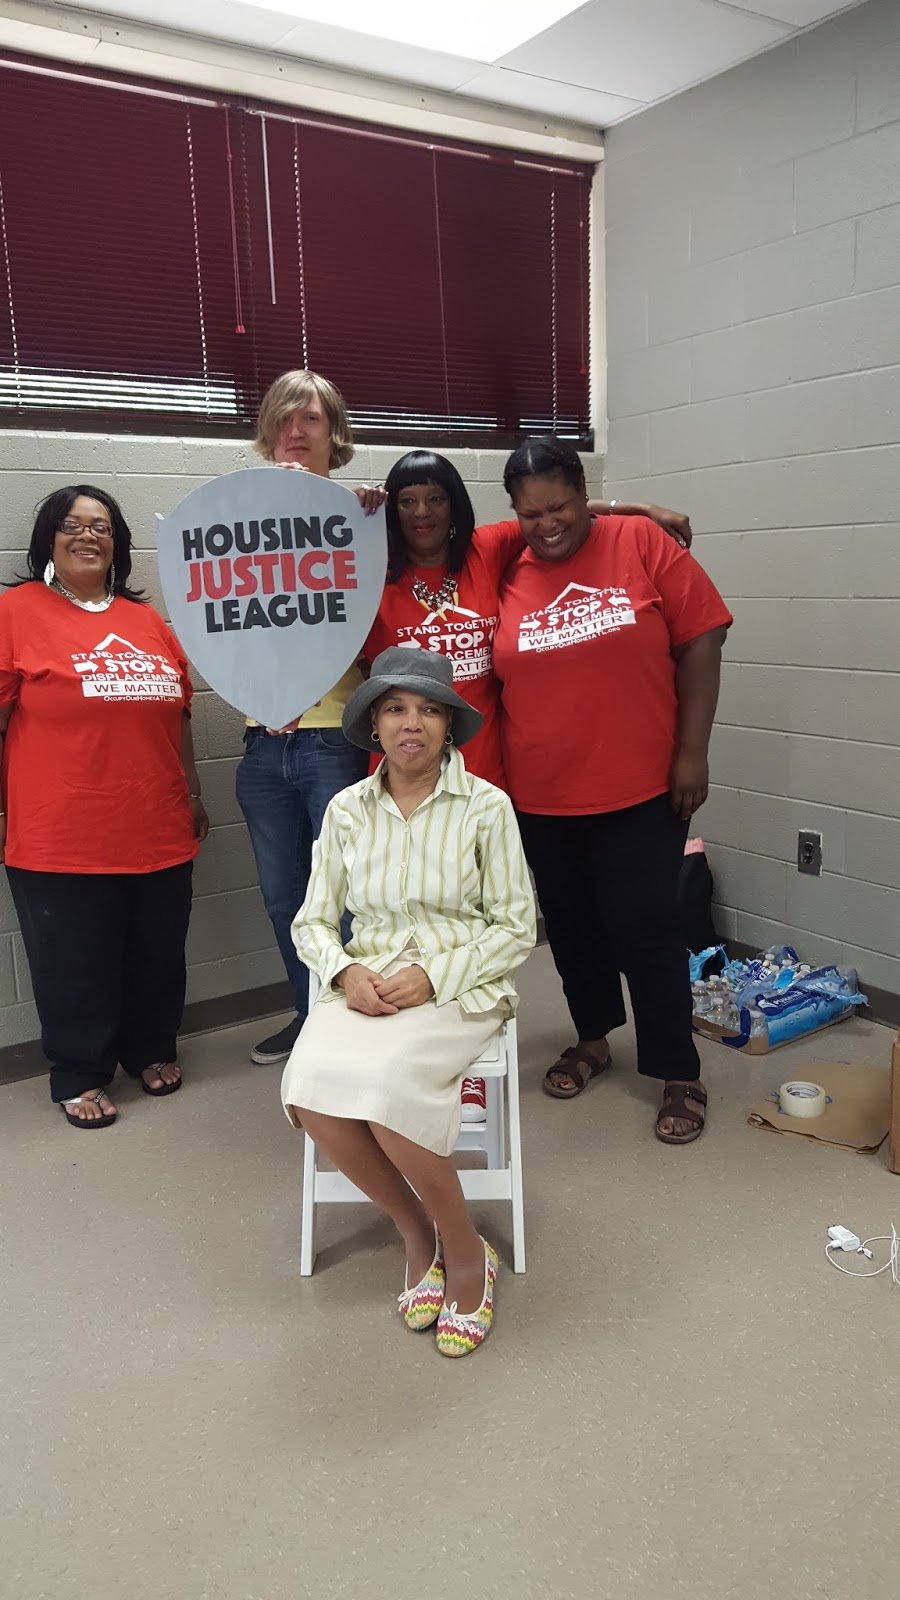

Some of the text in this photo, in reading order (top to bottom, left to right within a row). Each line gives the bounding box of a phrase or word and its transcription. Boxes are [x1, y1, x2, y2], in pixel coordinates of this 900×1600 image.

[182, 515, 354, 561] HOUSING
[187, 550, 358, 603] JUSTICE
[205, 591, 347, 633] LEAGUE
[522, 586, 627, 622] STAND TOGETHER
[547, 600, 602, 626] STOP
[397, 616, 497, 638] STAND TOGETHER
[519, 606, 632, 638] DISPLACEMENT
[528, 615, 624, 646] WE MATTER
[428, 631, 485, 652] STOP
[71, 651, 113, 661] STAND
[104, 659, 156, 673] STOP
[82, 673, 181, 683] DISPLACEMENT
[93, 684, 177, 694] WE MATTER
